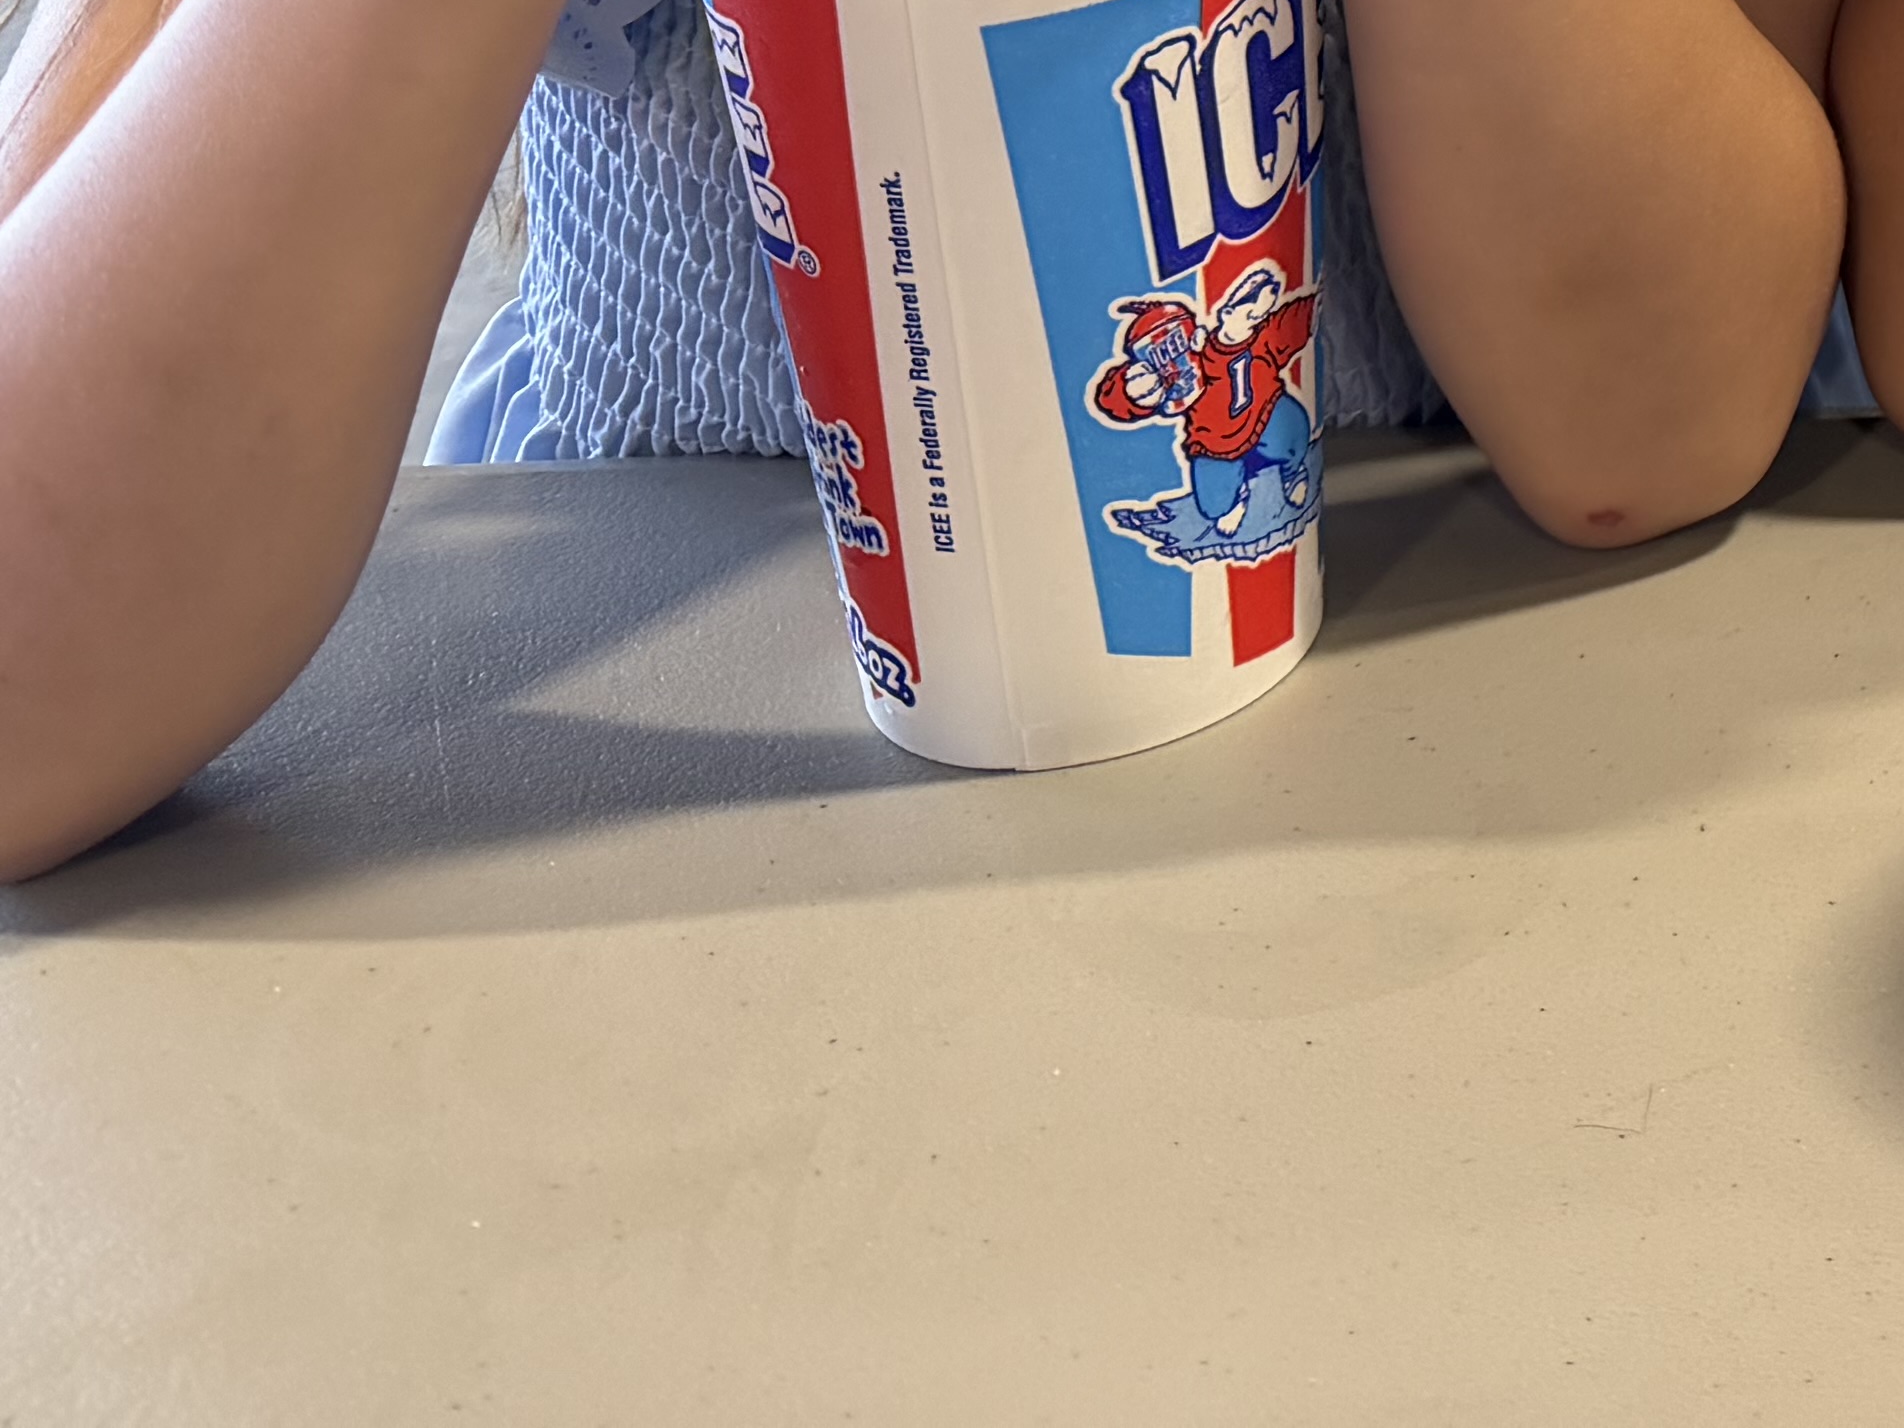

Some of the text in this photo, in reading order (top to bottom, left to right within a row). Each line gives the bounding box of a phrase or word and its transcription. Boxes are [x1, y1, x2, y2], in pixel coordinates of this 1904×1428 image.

[879, 171, 955, 553] ICEE is a Federally Registered Trademark.
[1149, 328, 1190, 370] ICEE
